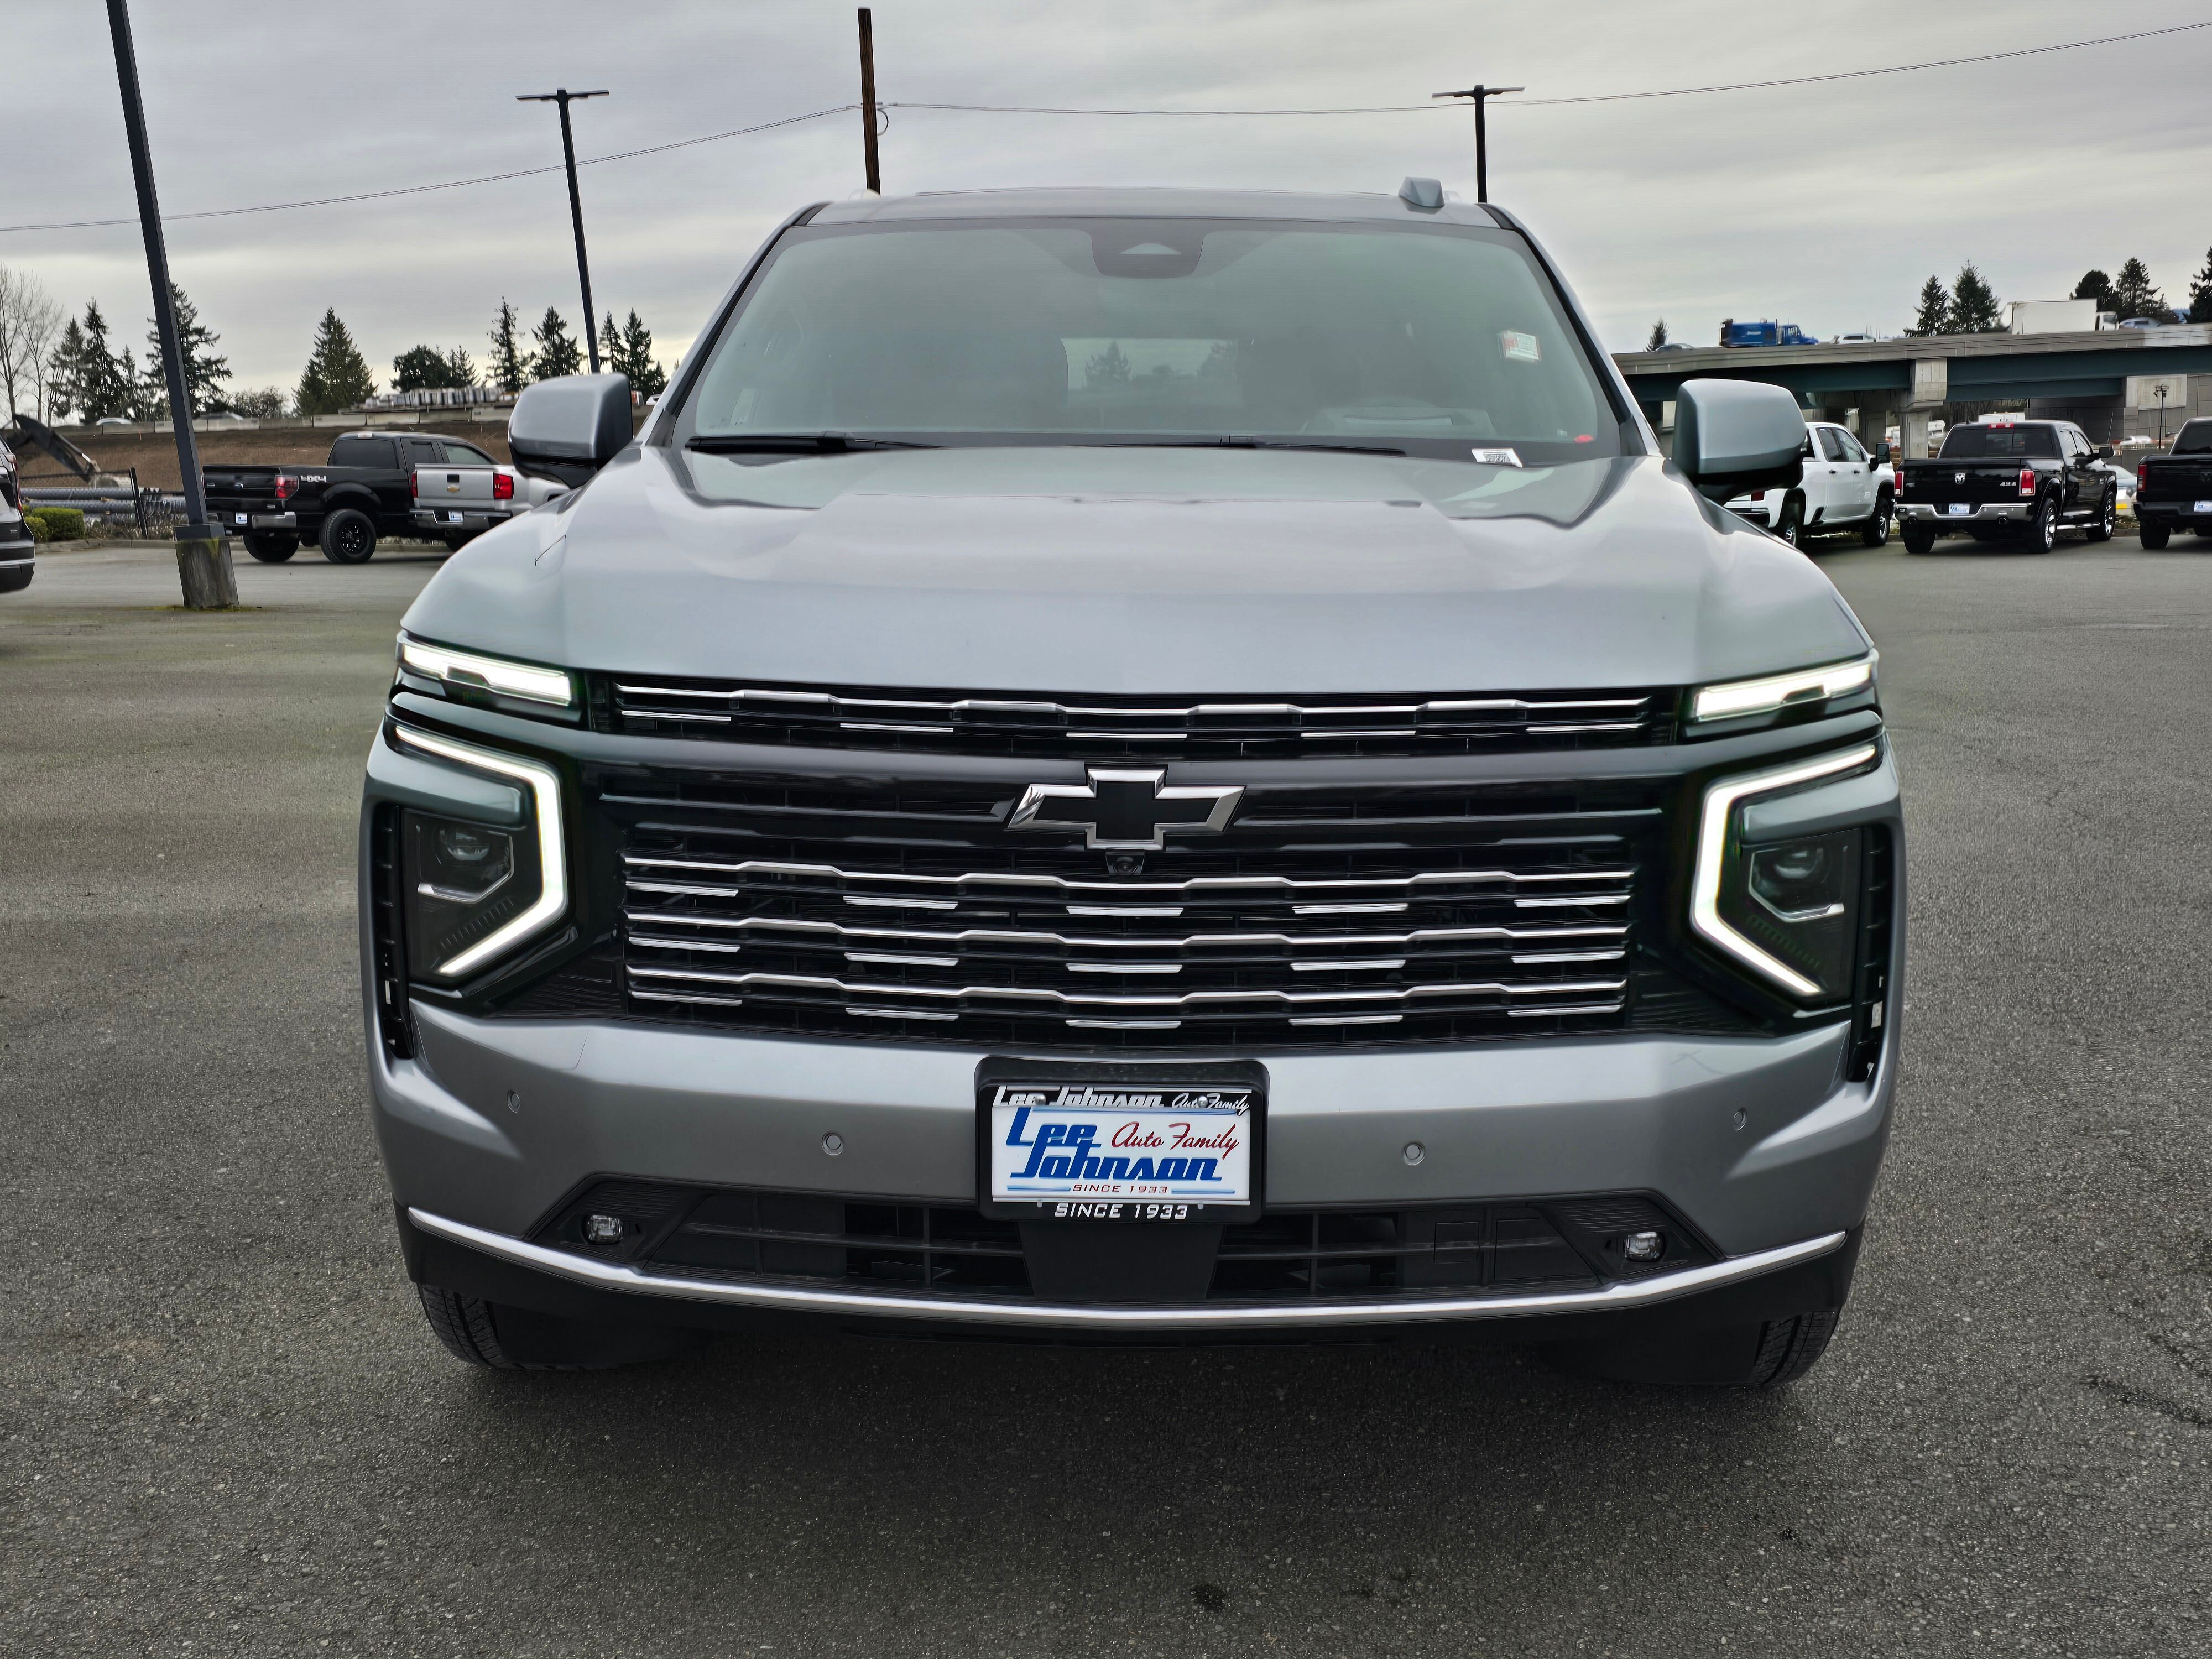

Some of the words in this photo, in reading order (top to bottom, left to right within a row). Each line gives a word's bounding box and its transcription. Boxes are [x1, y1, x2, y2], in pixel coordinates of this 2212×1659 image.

[1048, 1086, 1164, 1108] Johnson
[1206, 1093, 1250, 1116] Family
[1006, 1106, 1102, 1147] Lee
[1112, 1121, 1165, 1149] Auto
[1168, 1122, 1239, 1160] Family
[1010, 1144, 1222, 1182] Johnson
[1073, 1184, 1121, 1193] SINCE
[1130, 1185, 1168, 1194] 1933
[1055, 1202, 1123, 1219] SINCE
[1135, 1204, 1188, 1220] 1933
